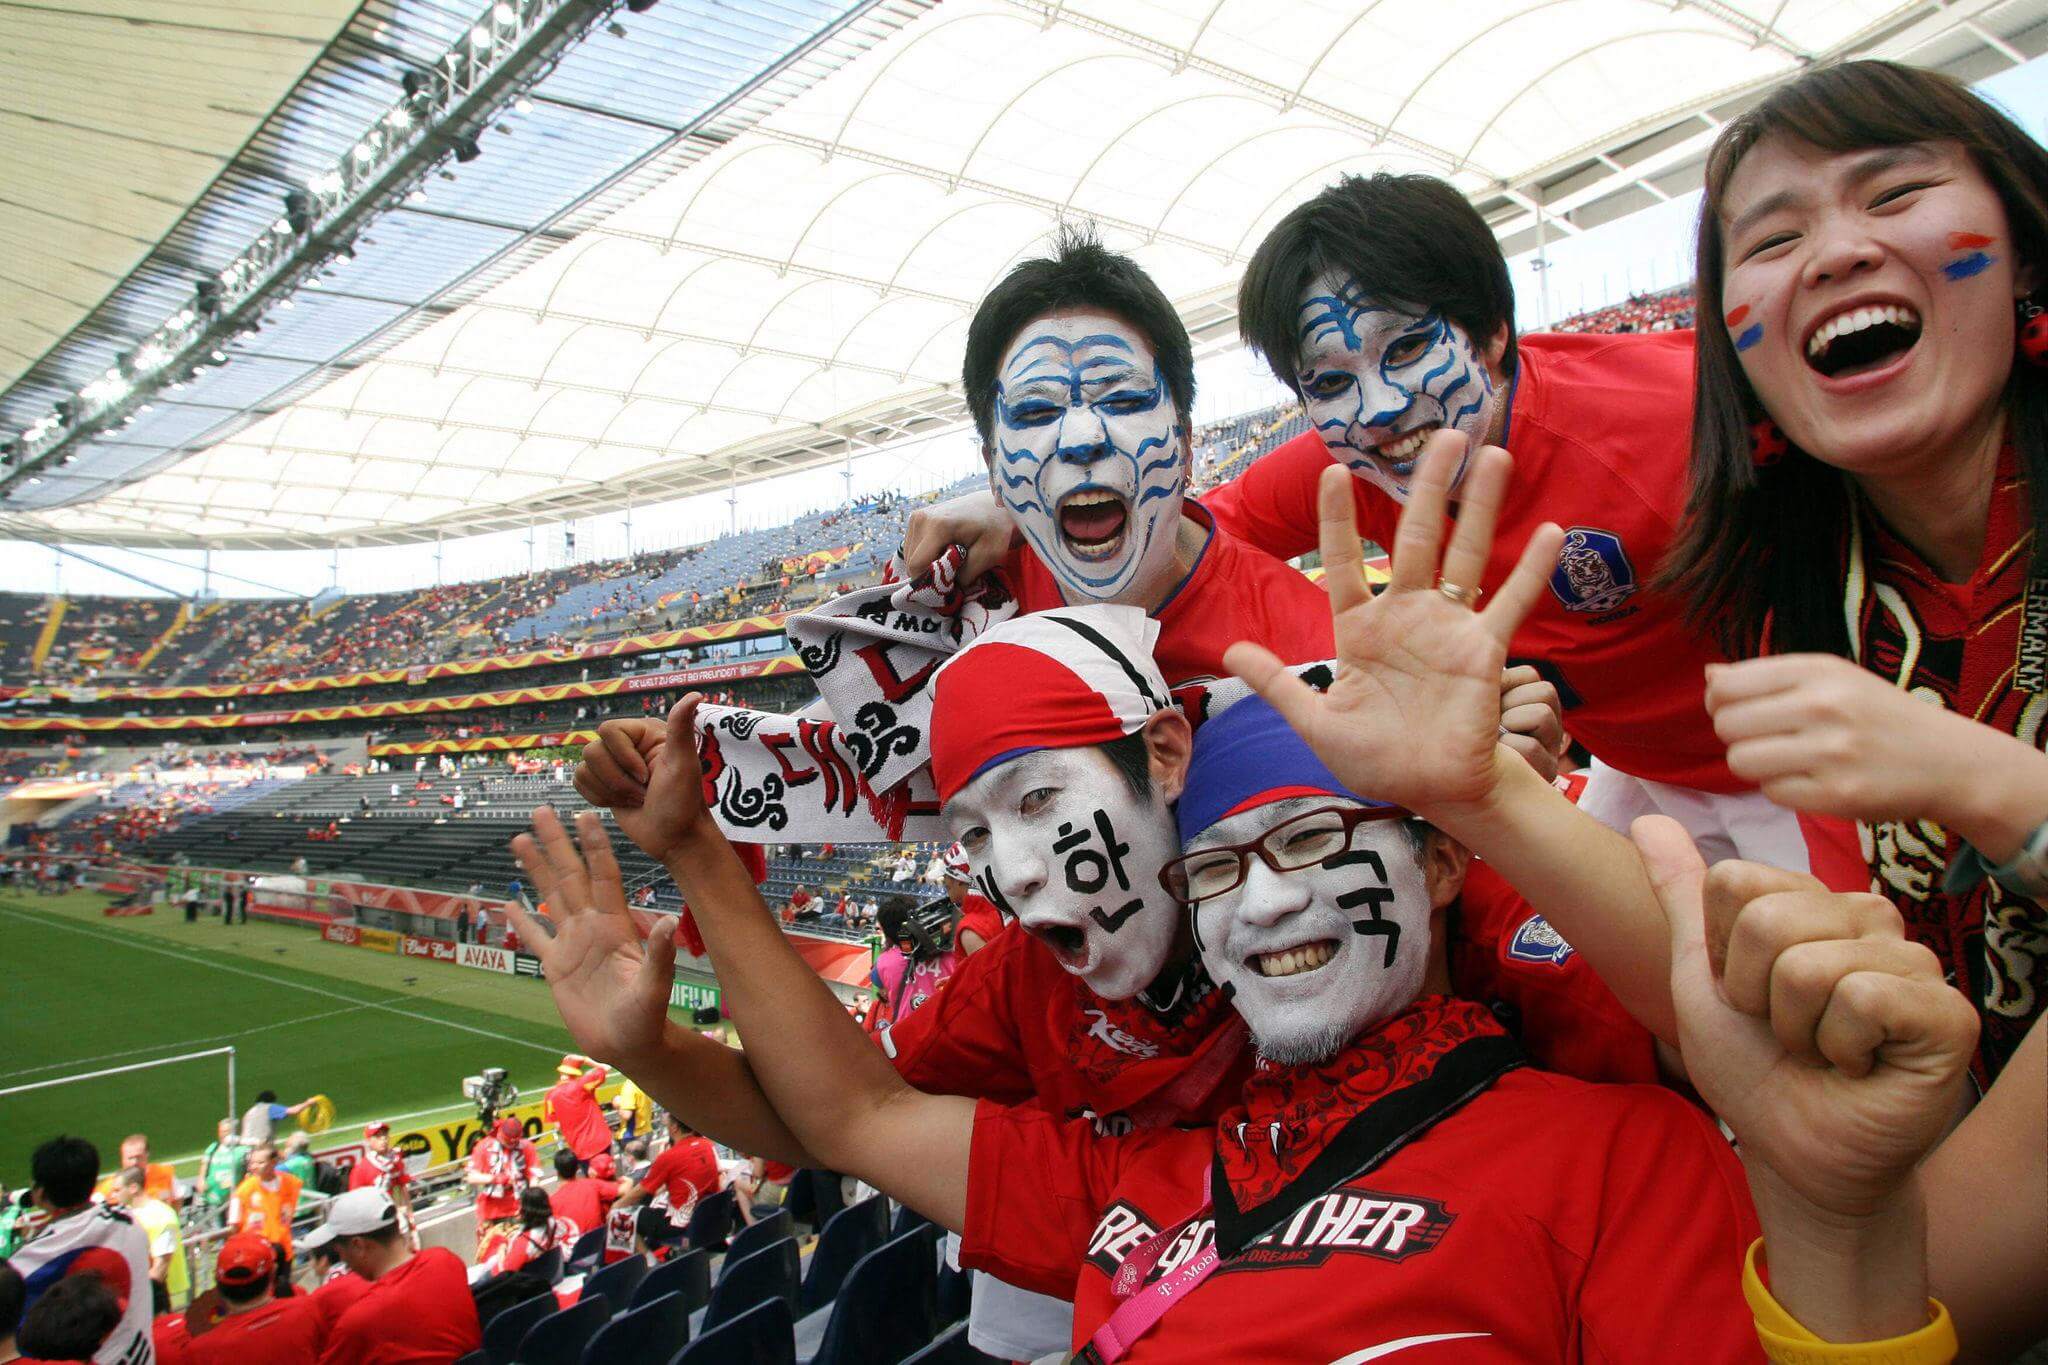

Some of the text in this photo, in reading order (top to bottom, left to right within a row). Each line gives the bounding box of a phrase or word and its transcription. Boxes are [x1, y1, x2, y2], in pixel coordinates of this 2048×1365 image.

[628, 679, 640, 689] DIE
[640, 678, 659, 688] WELT
[669, 673, 687, 685] GAST
[687, 672, 699, 682] BEI
[699, 667, 737, 681] FREUNDEN
[2018, 577, 2048, 693] ERMANY
[1052, 808, 1144, 934] 한
[1322, 849, 1401, 969] 국
[464, 948, 506, 970] AVAYA
